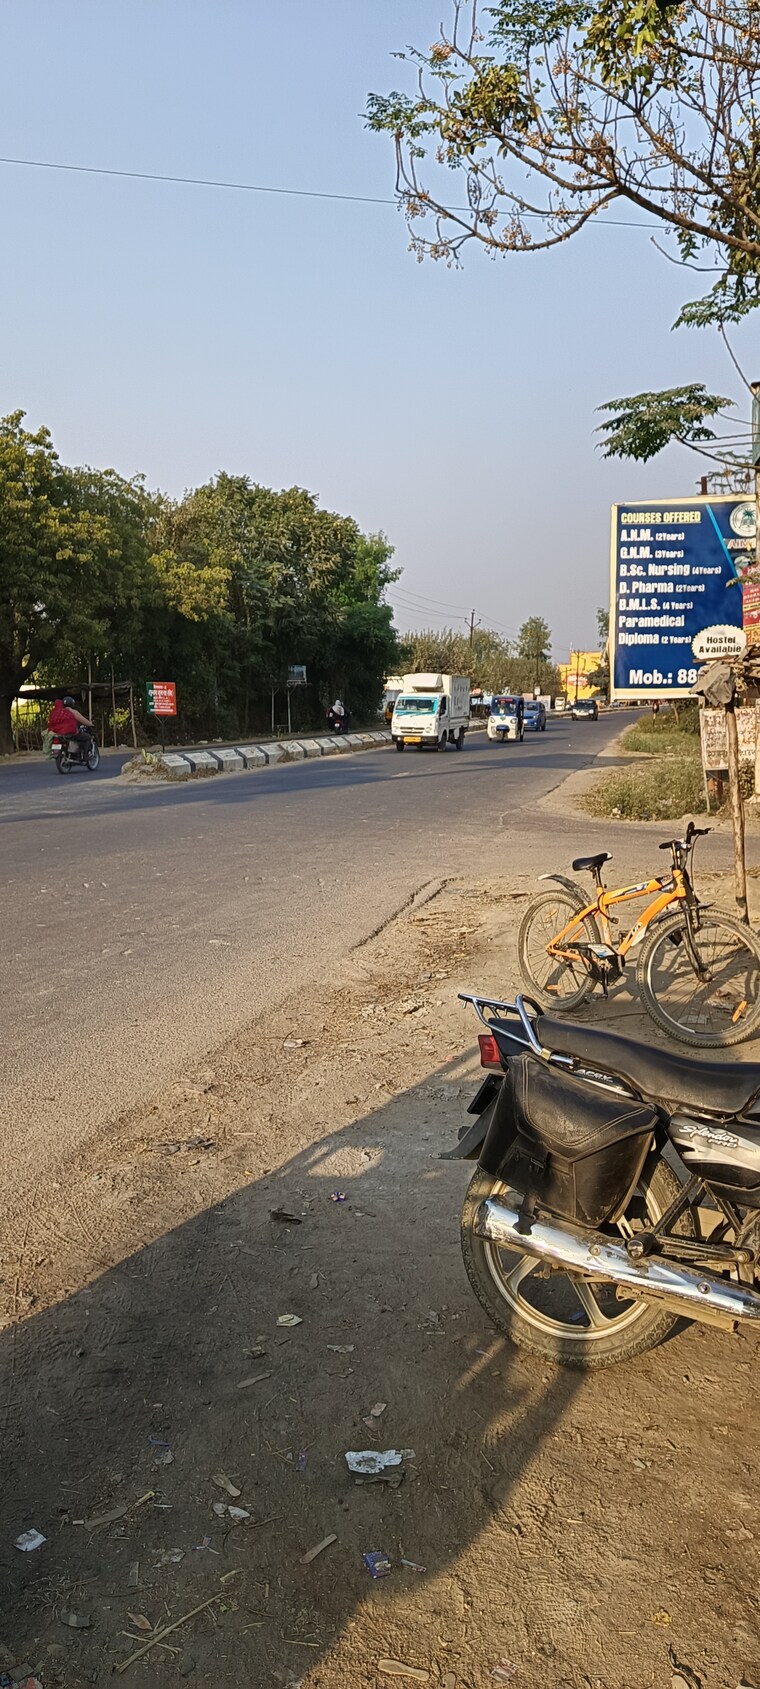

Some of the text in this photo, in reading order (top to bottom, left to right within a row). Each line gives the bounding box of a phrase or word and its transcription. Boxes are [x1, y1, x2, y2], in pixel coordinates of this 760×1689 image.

[621, 511, 701, 523] COURSES OFFERED
[620, 529, 685, 541] A.N.M. (2Years)
[620, 546, 684, 558] G.N.M. (3Years)
[620, 563, 722, 576] B.Sc. Nursing (4Years)
[619, 581, 705, 593] D. Pharma (2Years)
[618, 598, 661, 611] B.M.L.S.
[671, 601, 693, 610] Years)
[618, 615, 685, 628] Paramedical
[618, 633, 659, 646] Diploma
[706, 636, 736, 644] Hostel
[699, 645, 742, 653] Available
[629, 668, 698, 685] Mob.: 88
[678, 1125, 738, 1143] Splendor
